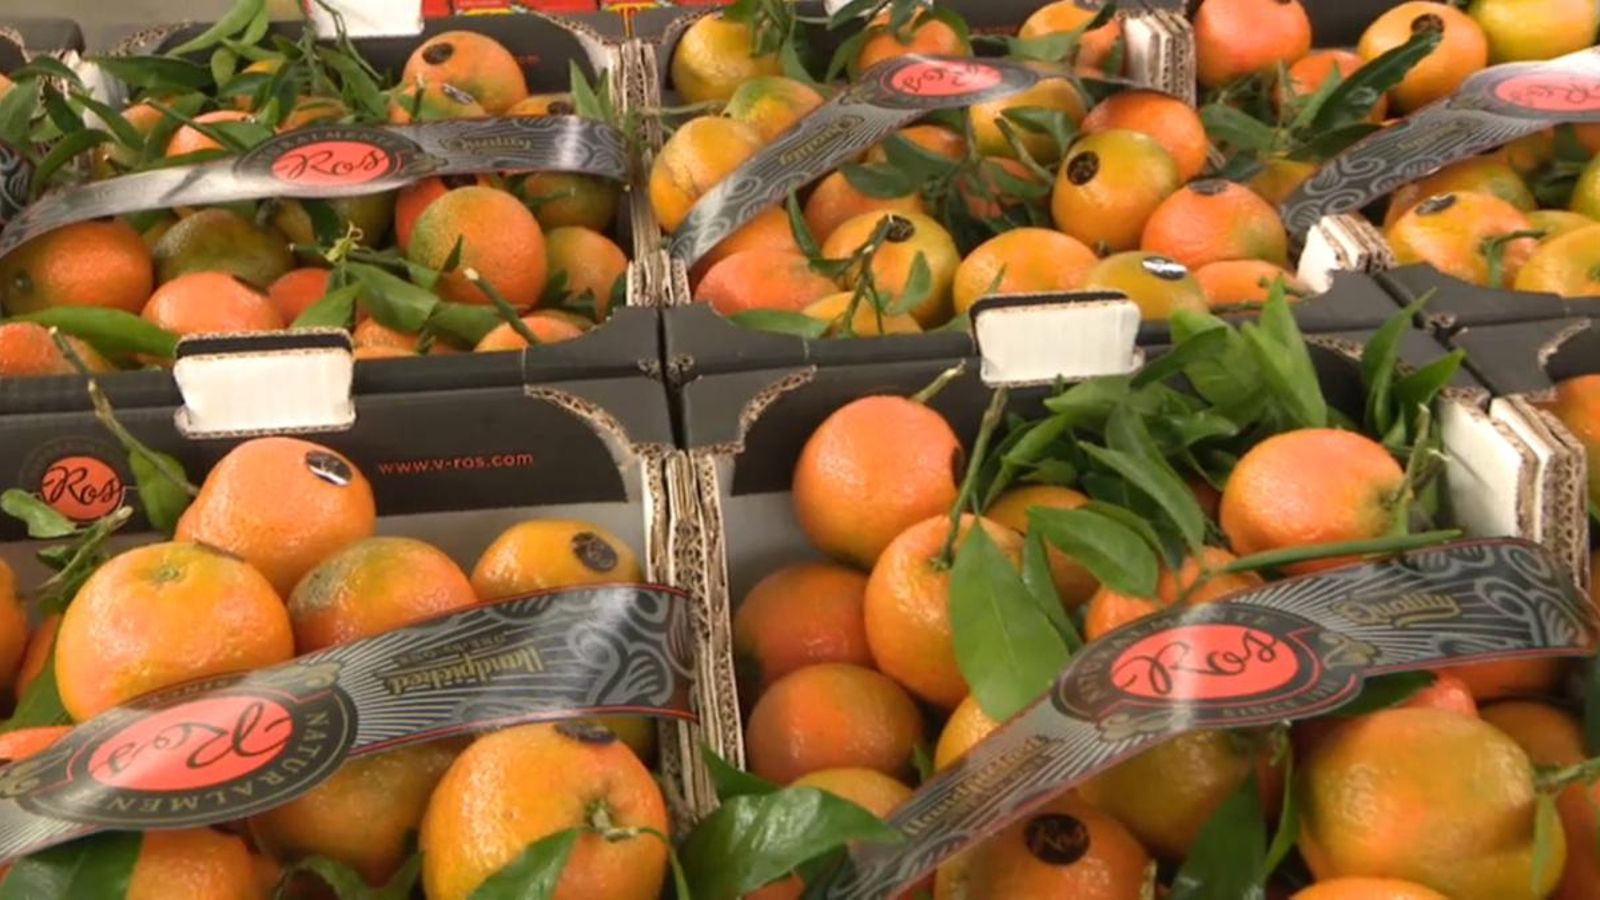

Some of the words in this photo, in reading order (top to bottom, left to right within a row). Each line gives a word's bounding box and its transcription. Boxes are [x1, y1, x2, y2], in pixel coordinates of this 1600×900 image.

[274, 149, 388, 181] Ros
[378, 452, 534, 475] www.v-ros.com
[42, 465, 122, 507] Ros
[1332, 593, 1462, 629] Quality
[387, 646, 543, 694] Handpicked
[1113, 631, 1276, 696] Ros
[90, 702, 292, 778] Ros
